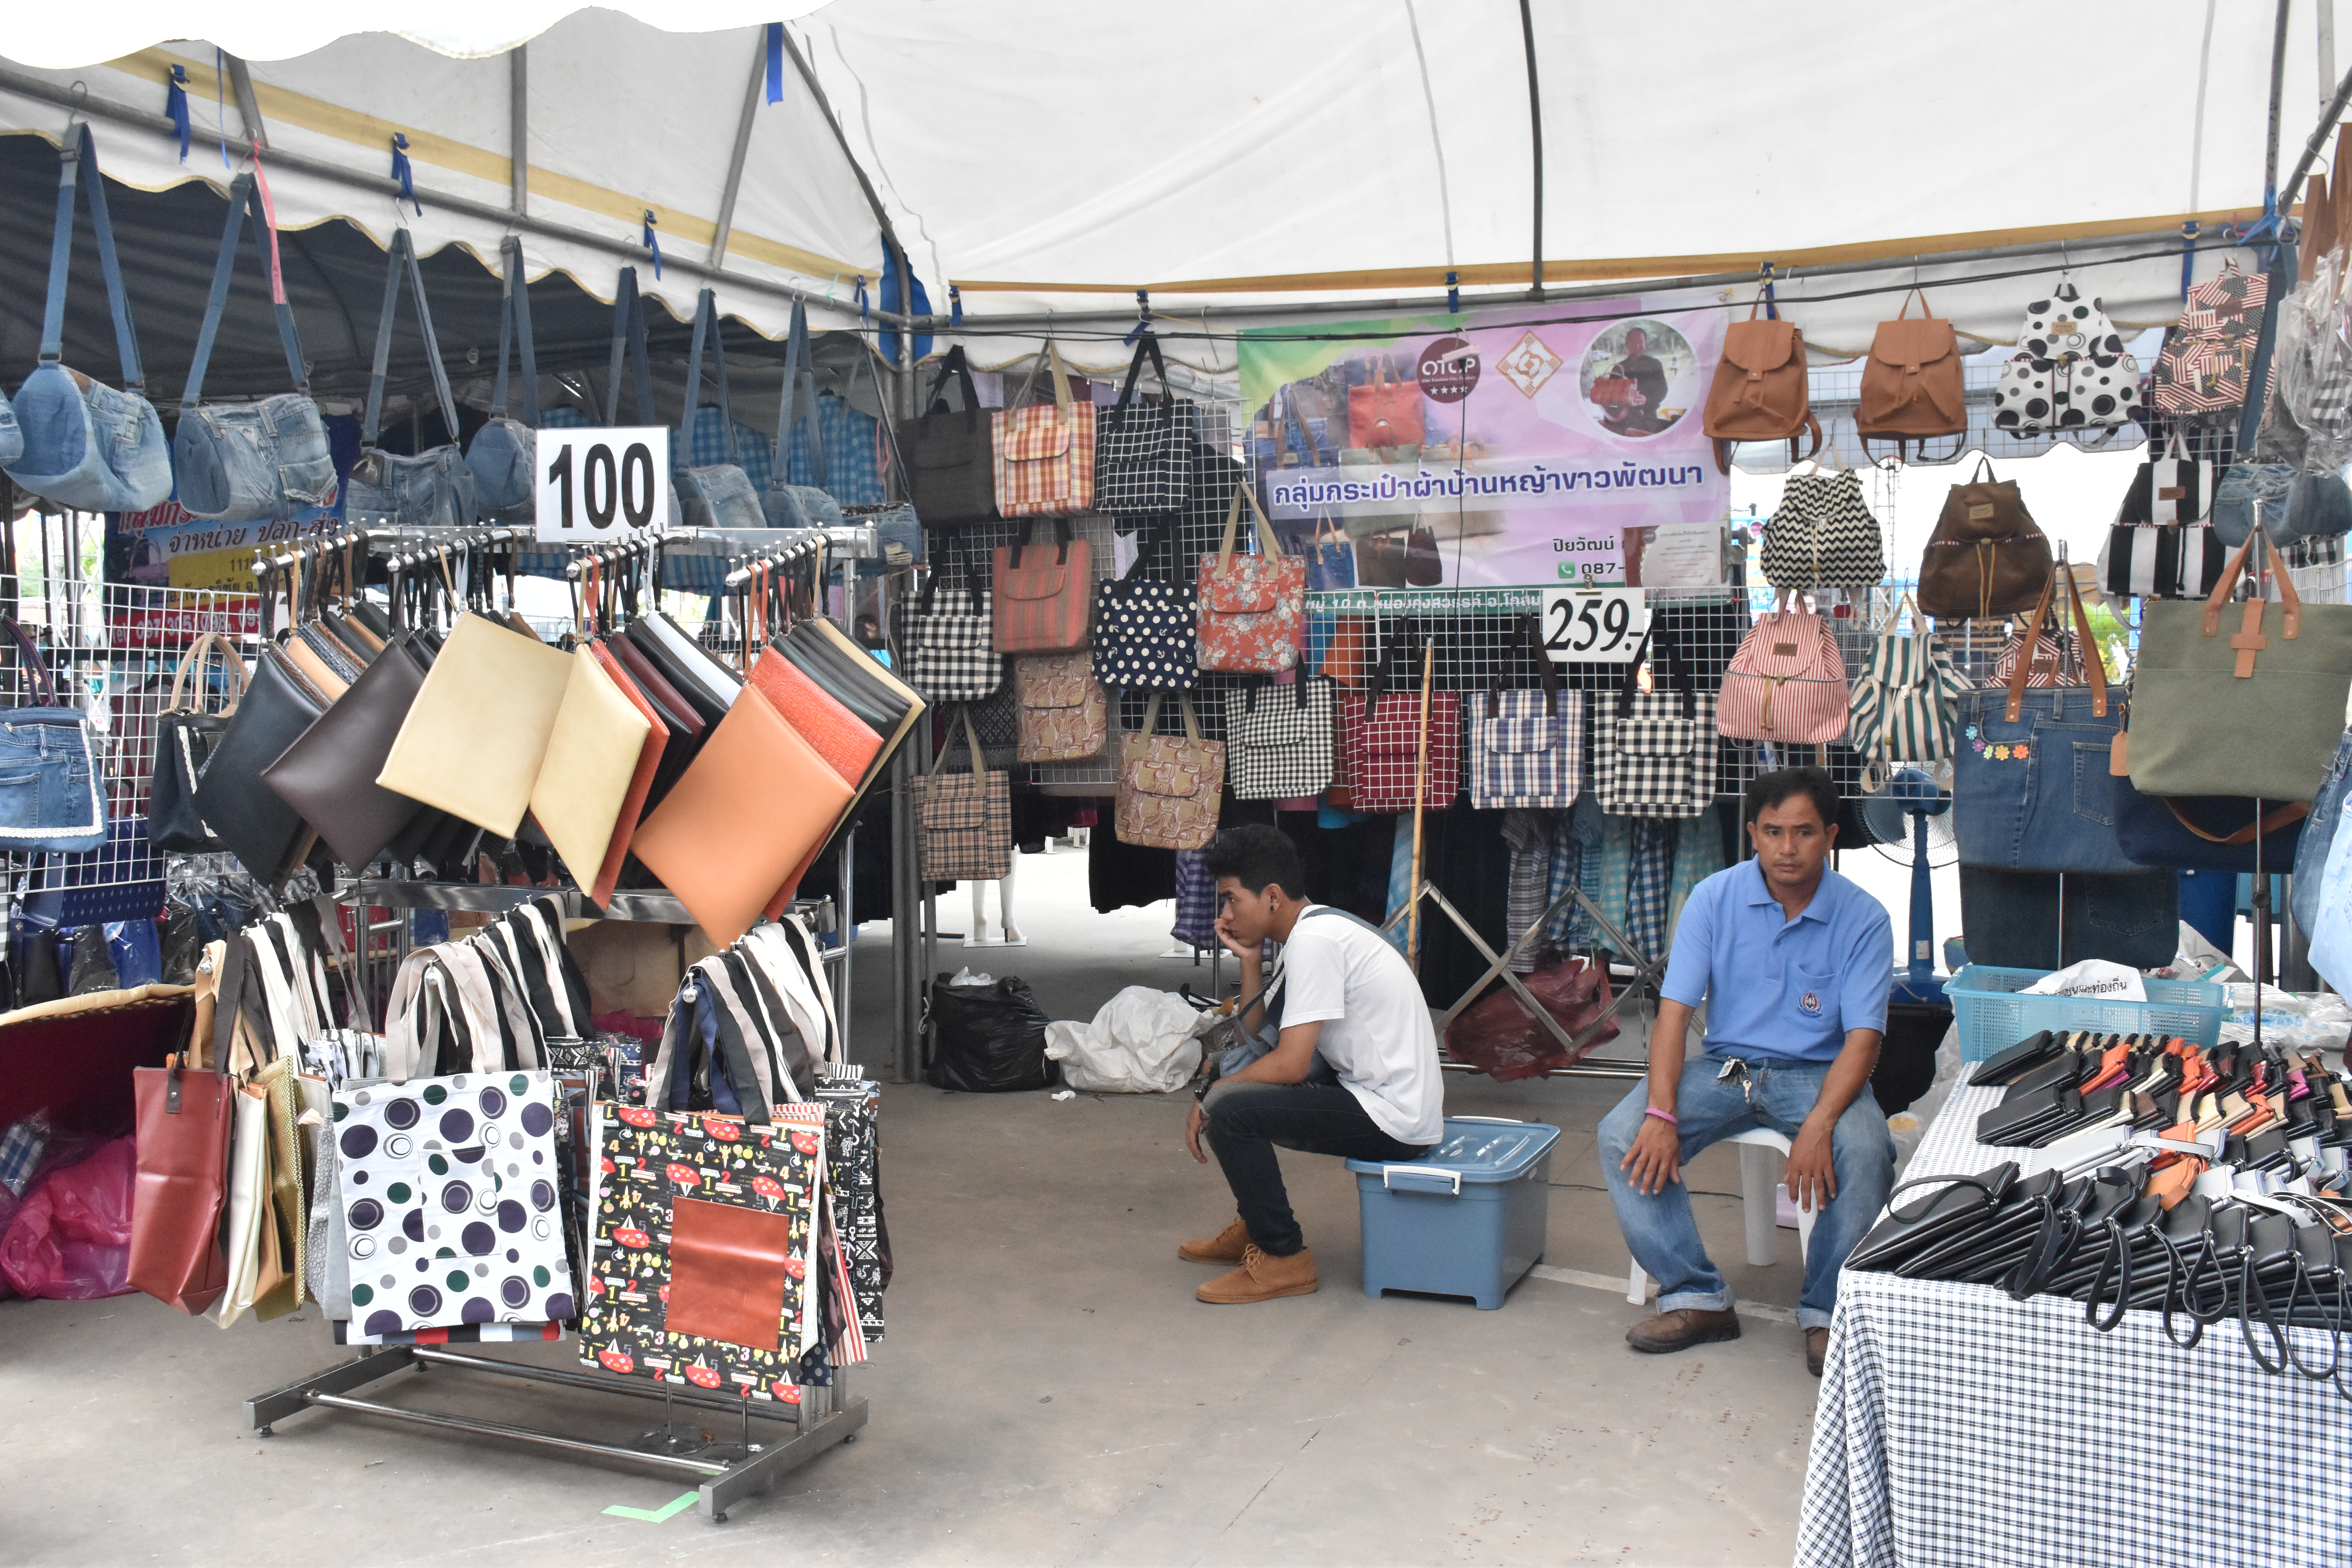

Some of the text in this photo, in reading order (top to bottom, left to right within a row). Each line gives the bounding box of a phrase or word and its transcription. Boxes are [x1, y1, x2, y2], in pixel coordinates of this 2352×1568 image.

[549, 443, 655, 530] 100
[169, 523, 247, 553] จำหน่าย
[1553, 535, 1615, 552] ปิยวัฒน์
[1332, 599, 1350, 609] 10
